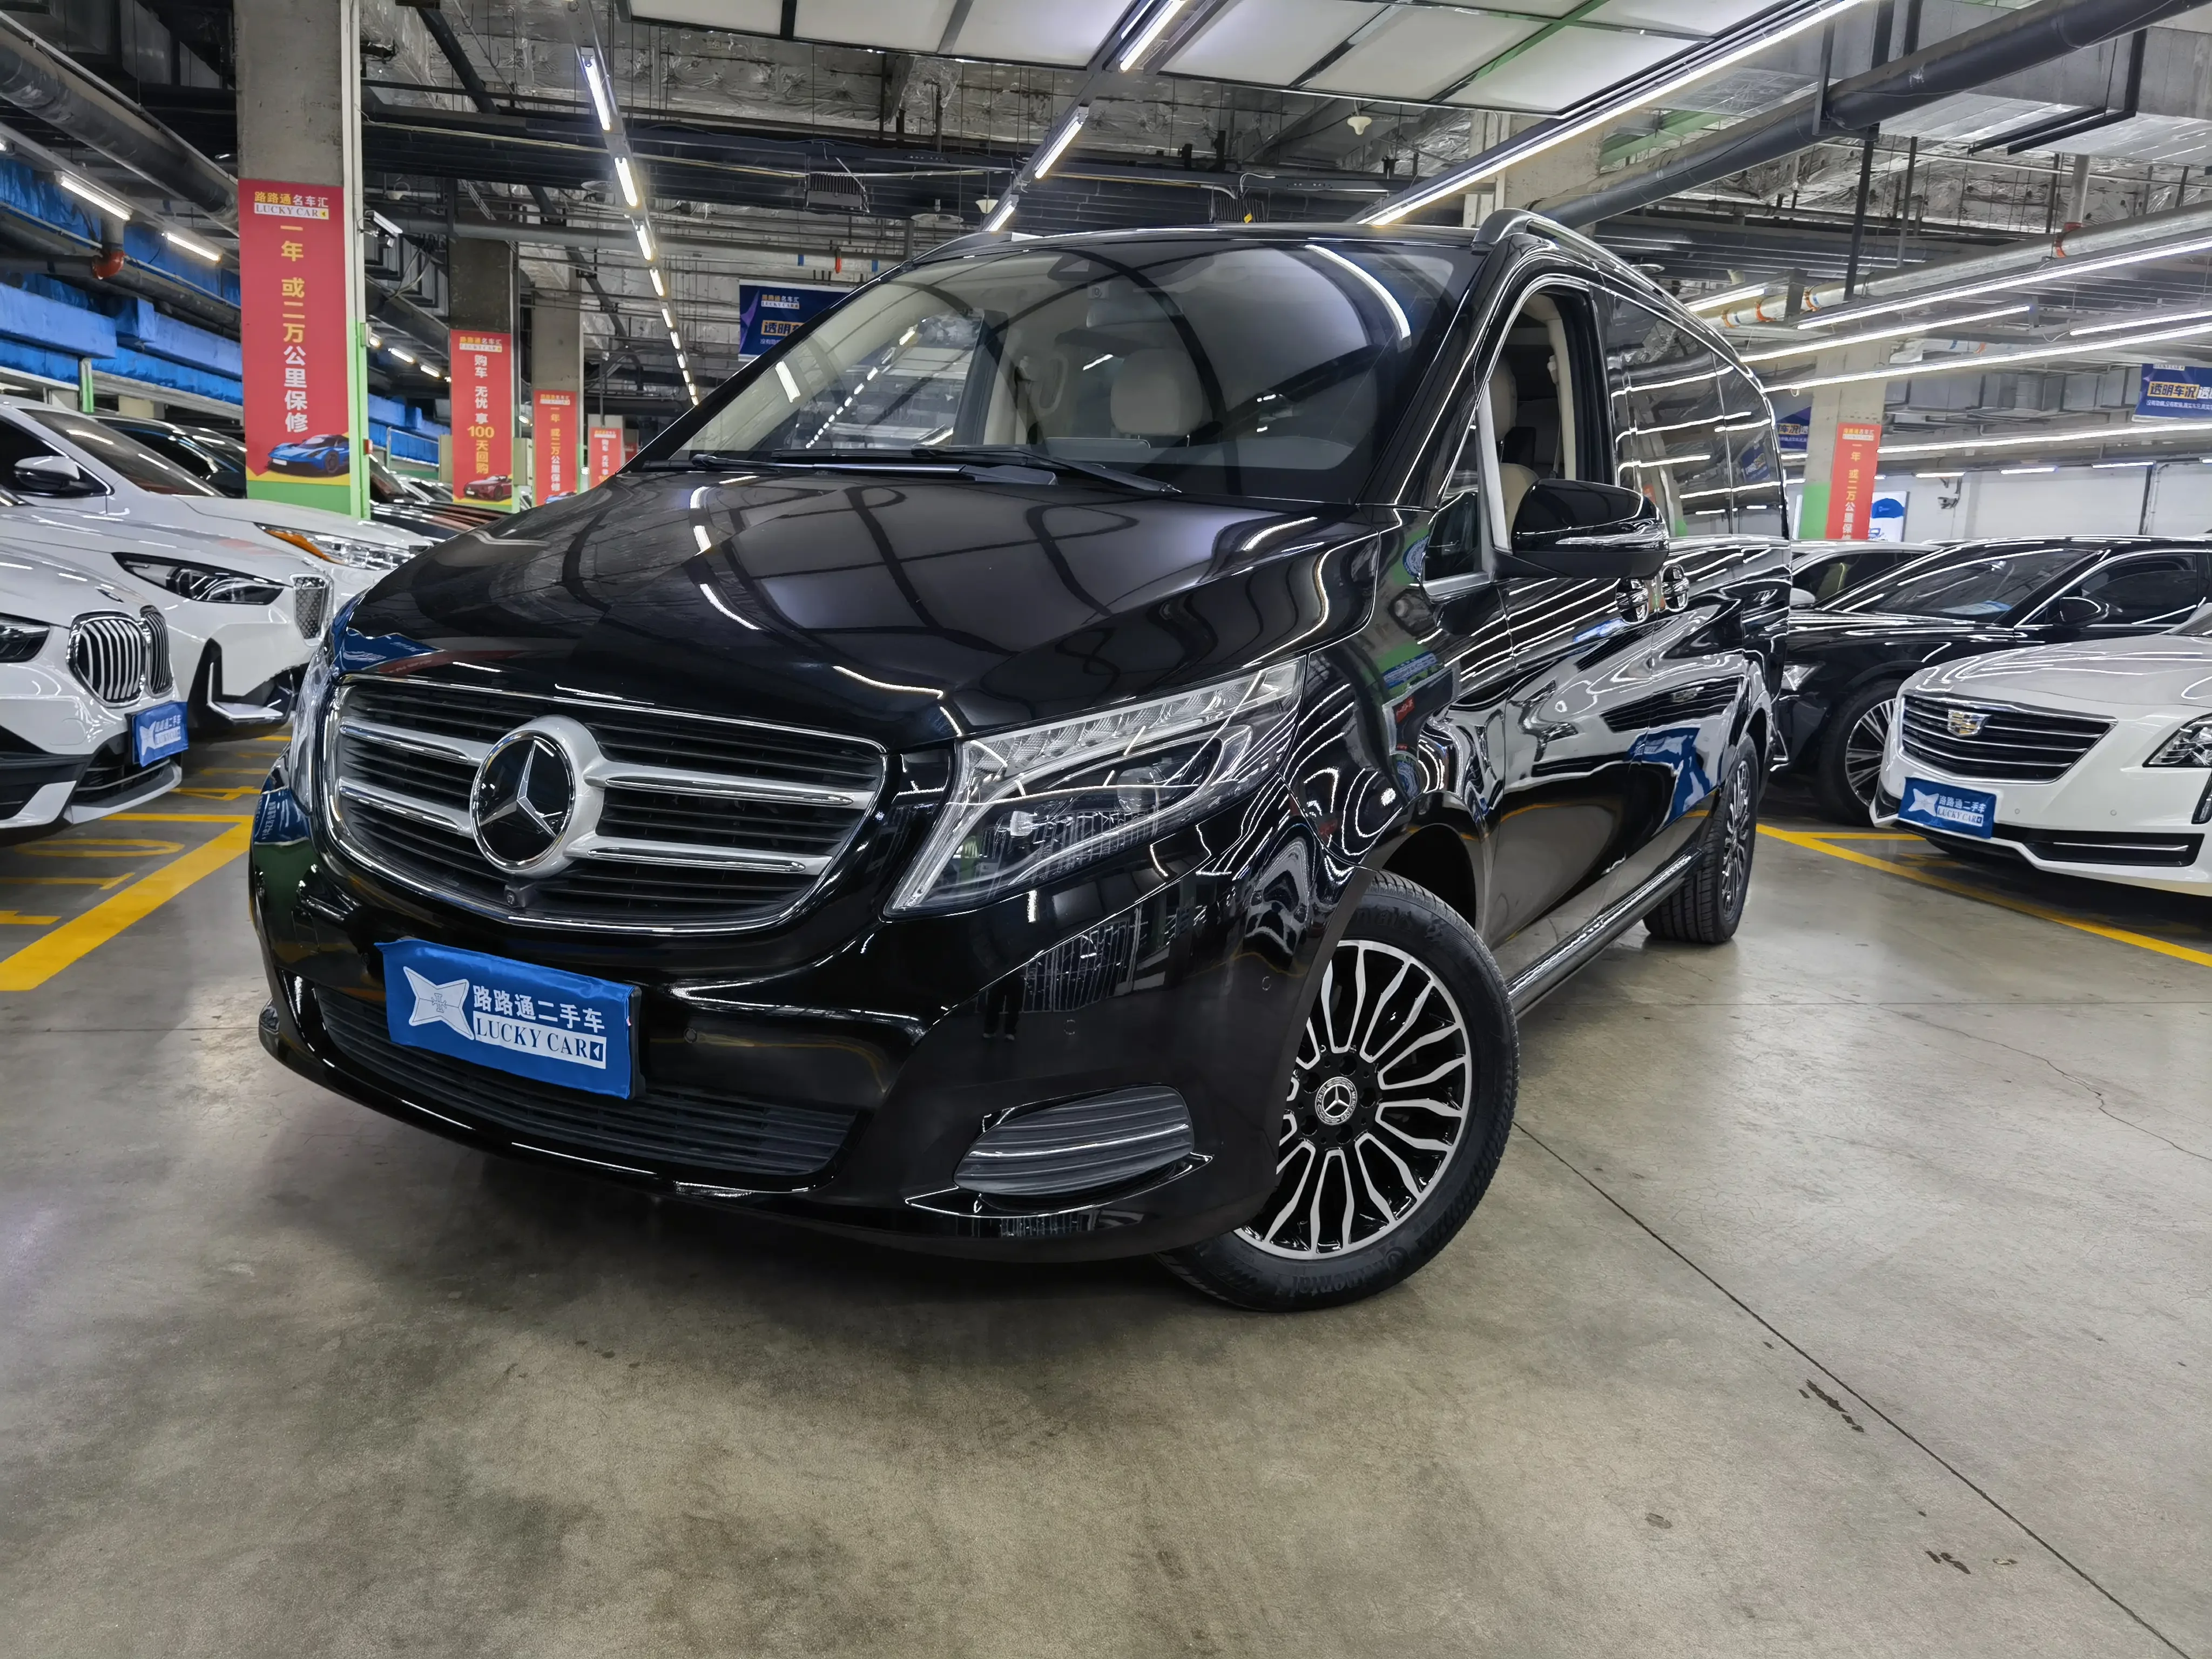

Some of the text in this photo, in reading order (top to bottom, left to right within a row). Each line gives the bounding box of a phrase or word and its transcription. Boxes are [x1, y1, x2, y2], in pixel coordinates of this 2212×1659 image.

[254, 191, 328, 207] 路路通名车汇
[256, 204, 319, 217] LUCKY CAR
[2150, 382, 2197, 398] 透明车况
[1939, 795, 1987, 813] 路路通二手车
[1938, 807, 1978, 824] LUCKY CAR
[473, 984, 605, 1034] 路路通二手车
[475, 1017, 588, 1058] LUCKY CAR
[1317, 1086, 1356, 1121] MERCEDES BENZ
